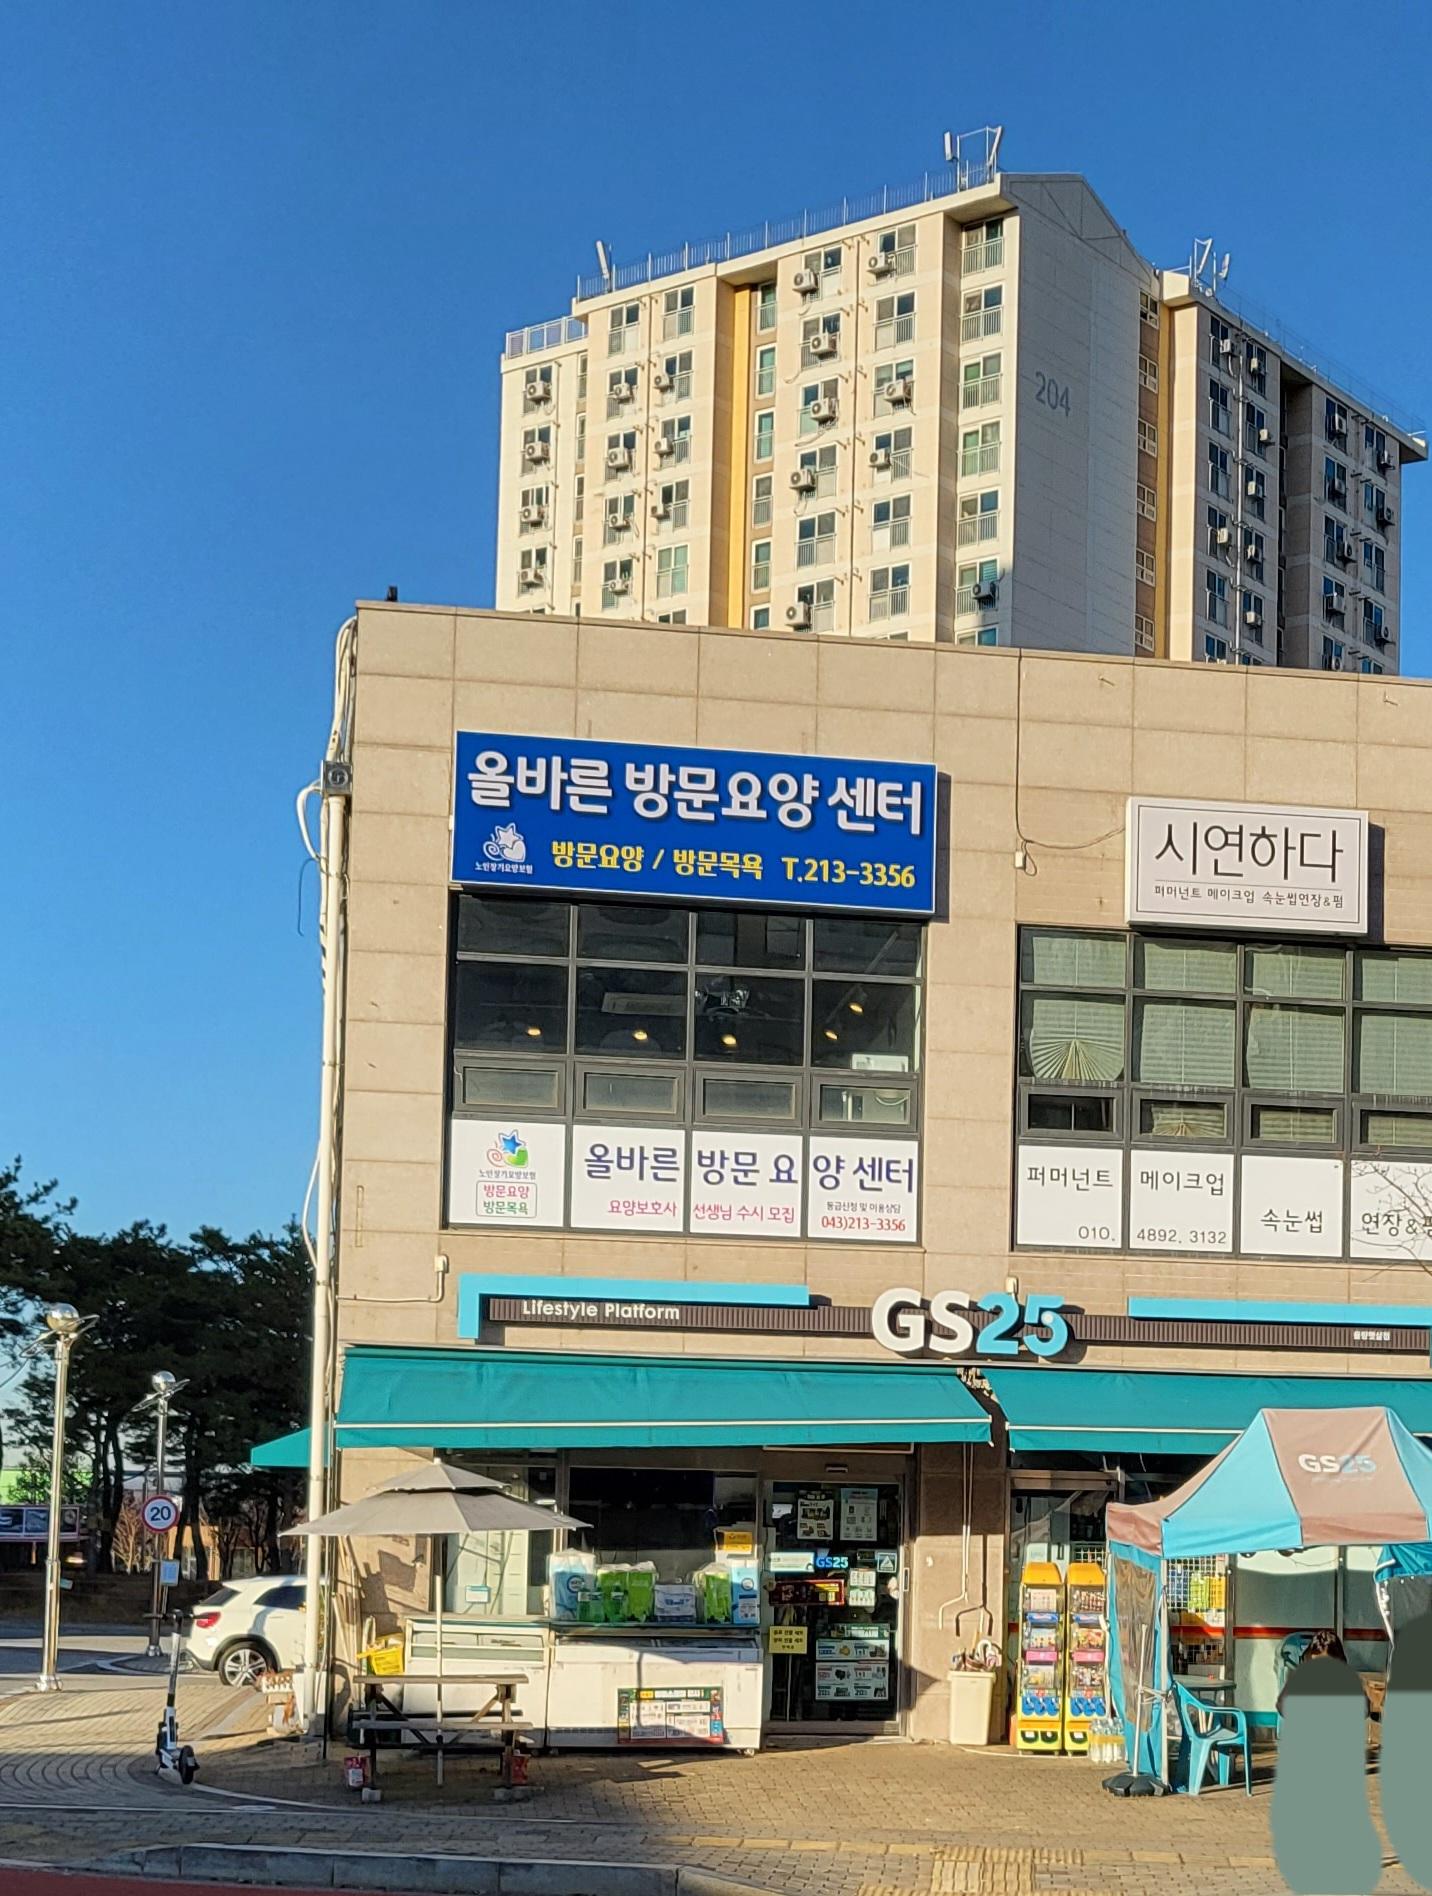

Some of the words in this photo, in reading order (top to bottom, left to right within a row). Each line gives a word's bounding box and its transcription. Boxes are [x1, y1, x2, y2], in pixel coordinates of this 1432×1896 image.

[1035, 371, 1070, 417] 204
[467, 750, 613, 814] 올바른
[625, 763, 820, 829] 방문요양
[827, 776, 922, 836] 센터
[551, 840, 644, 872] 방문요양
[673, 849, 763, 880] 방문목욕
[781, 857, 916, 888] T.213-3356
[1155, 821, 1344, 883] 시연하다
[1154, 885, 1202, 900] 퍼머넌트
[1207, 887, 1255, 904] 메이크업
[584, 1143, 681, 1182] 올바른
[697, 1149, 760, 1187] 방문
[852, 1156, 914, 1194] 센터
[483, 1184, 530, 1199] 방문요양
[1027, 1166, 1114, 1192] 퍼머넌트
[1140, 1169, 1225, 1197] 메이크업
[483, 1200, 529, 1215] 방문목욕
[607, 1199, 678, 1218] 요양보호사
[693, 1203, 732, 1221] 선생님
[737, 1205, 765, 1221] 수시
[767, 1206, 795, 1224] 모집
[821, 1216, 906, 1232] 043)213-3356
[1260, 1209, 1324, 1235] 속눈썹
[522, 1300, 599, 1321] Lifestyle
[604, 1302, 680, 1320] Platform
[872, 1287, 1068, 1357] GS25
[1298, 1453, 1377, 1473] GS25
[150, 1506, 171, 1522] 20
[816, 1556, 849, 1569] GS25
